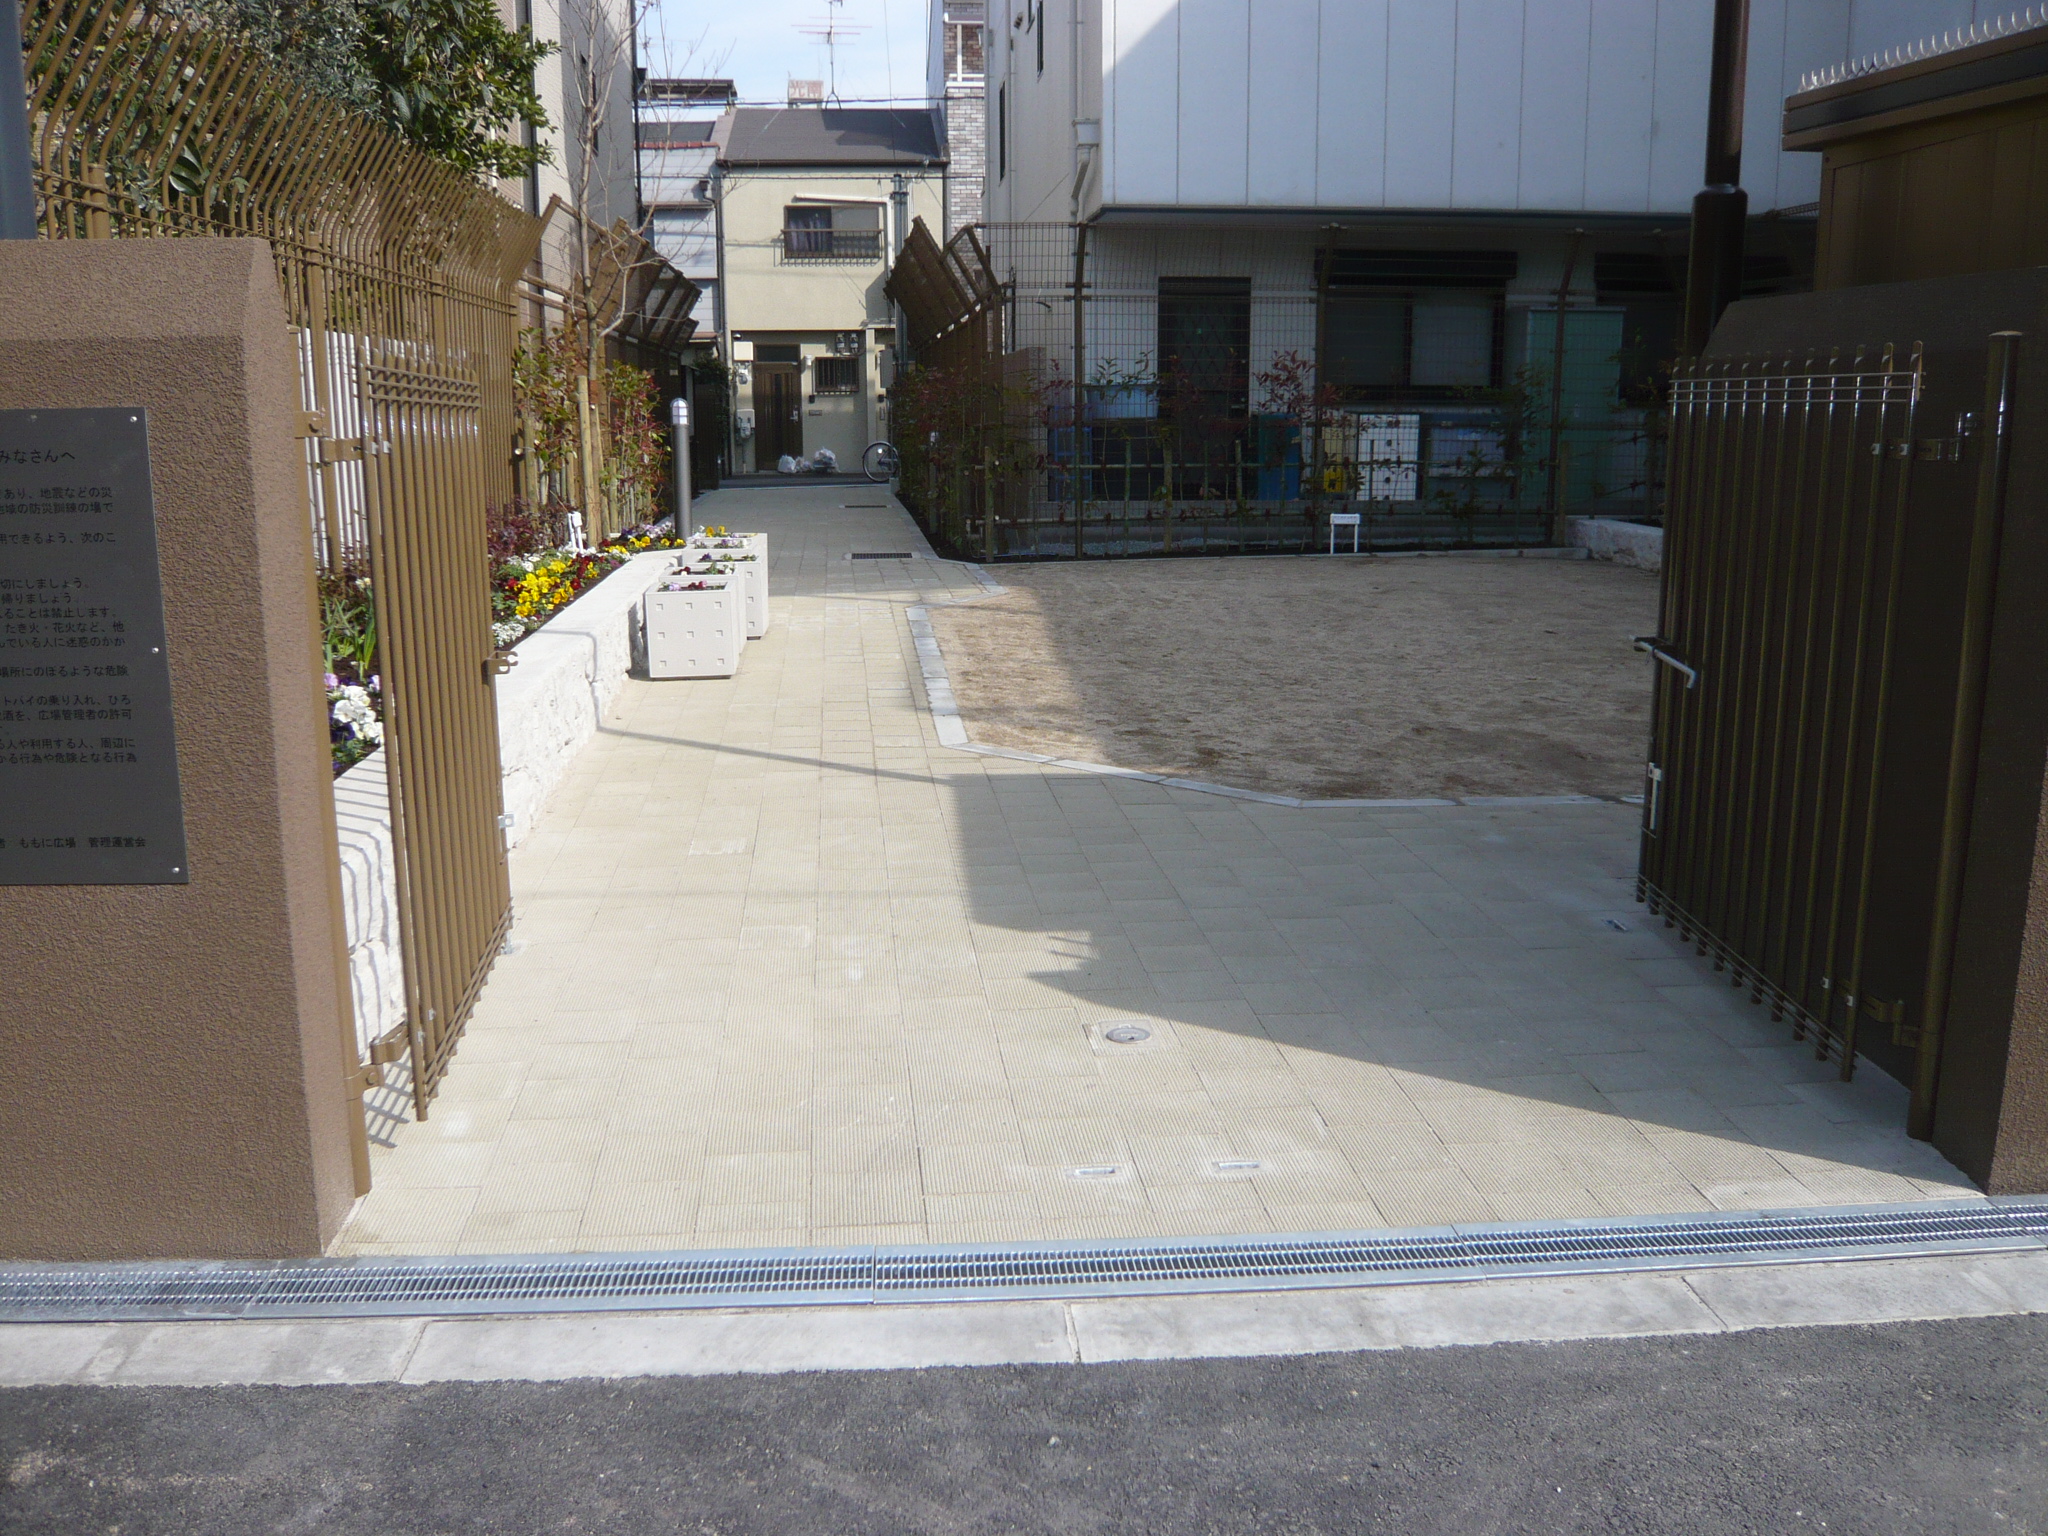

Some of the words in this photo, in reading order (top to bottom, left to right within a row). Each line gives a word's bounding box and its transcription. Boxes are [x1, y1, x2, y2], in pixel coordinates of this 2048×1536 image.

[0, 449, 75, 464] みなさんへ
[0, 607, 117, 618] ることは禁止します。
[0, 708, 132, 721] 酒を、広場管理者の許可
